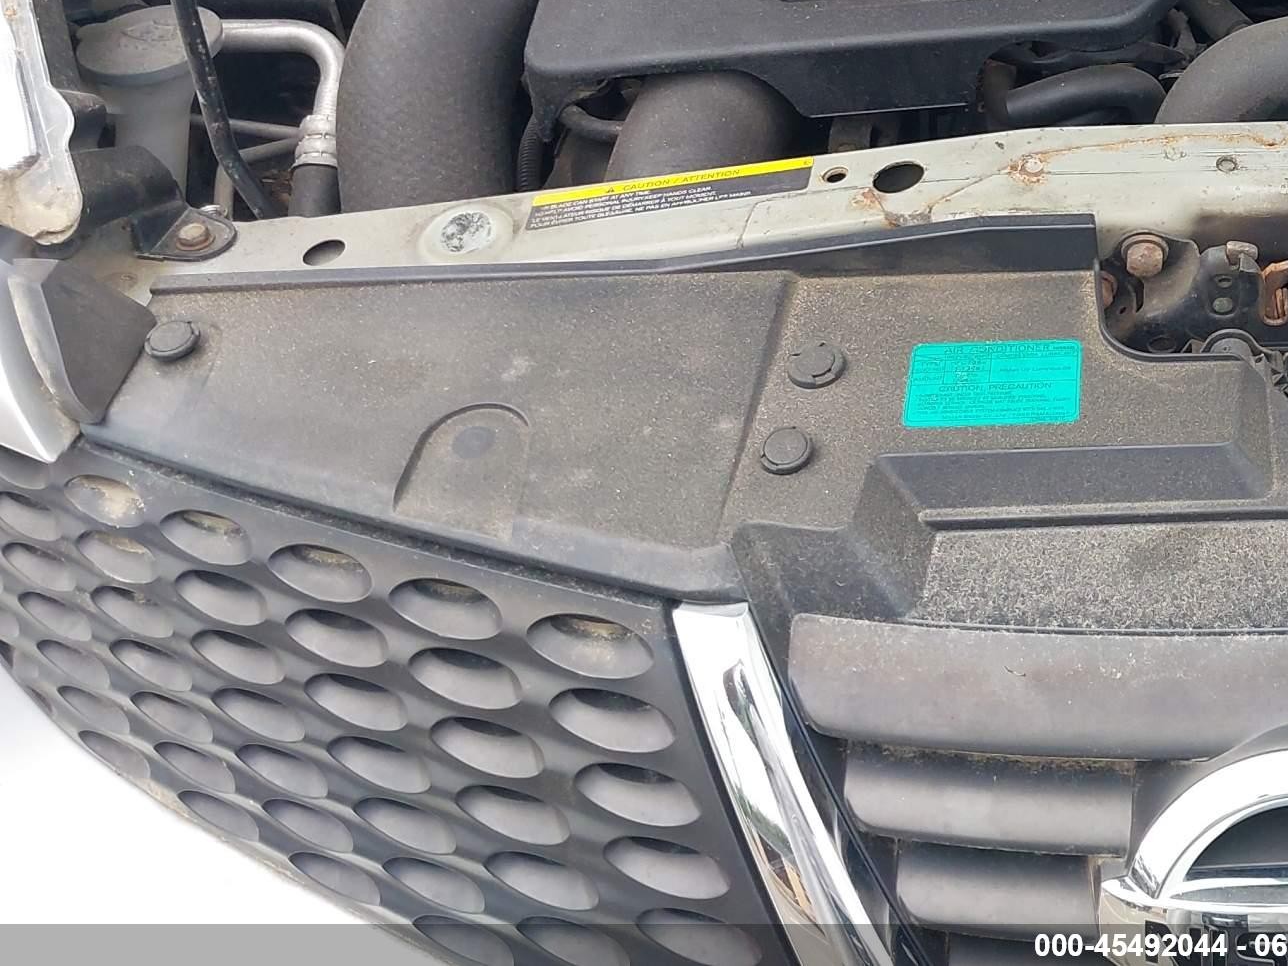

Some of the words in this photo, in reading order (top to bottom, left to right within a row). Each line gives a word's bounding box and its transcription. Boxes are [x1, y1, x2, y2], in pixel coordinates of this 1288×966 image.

[623, 179, 671, 191] CAUTION
[682, 169, 740, 182] ATTENTION
[987, 382, 1053, 392] PRECAUTION
